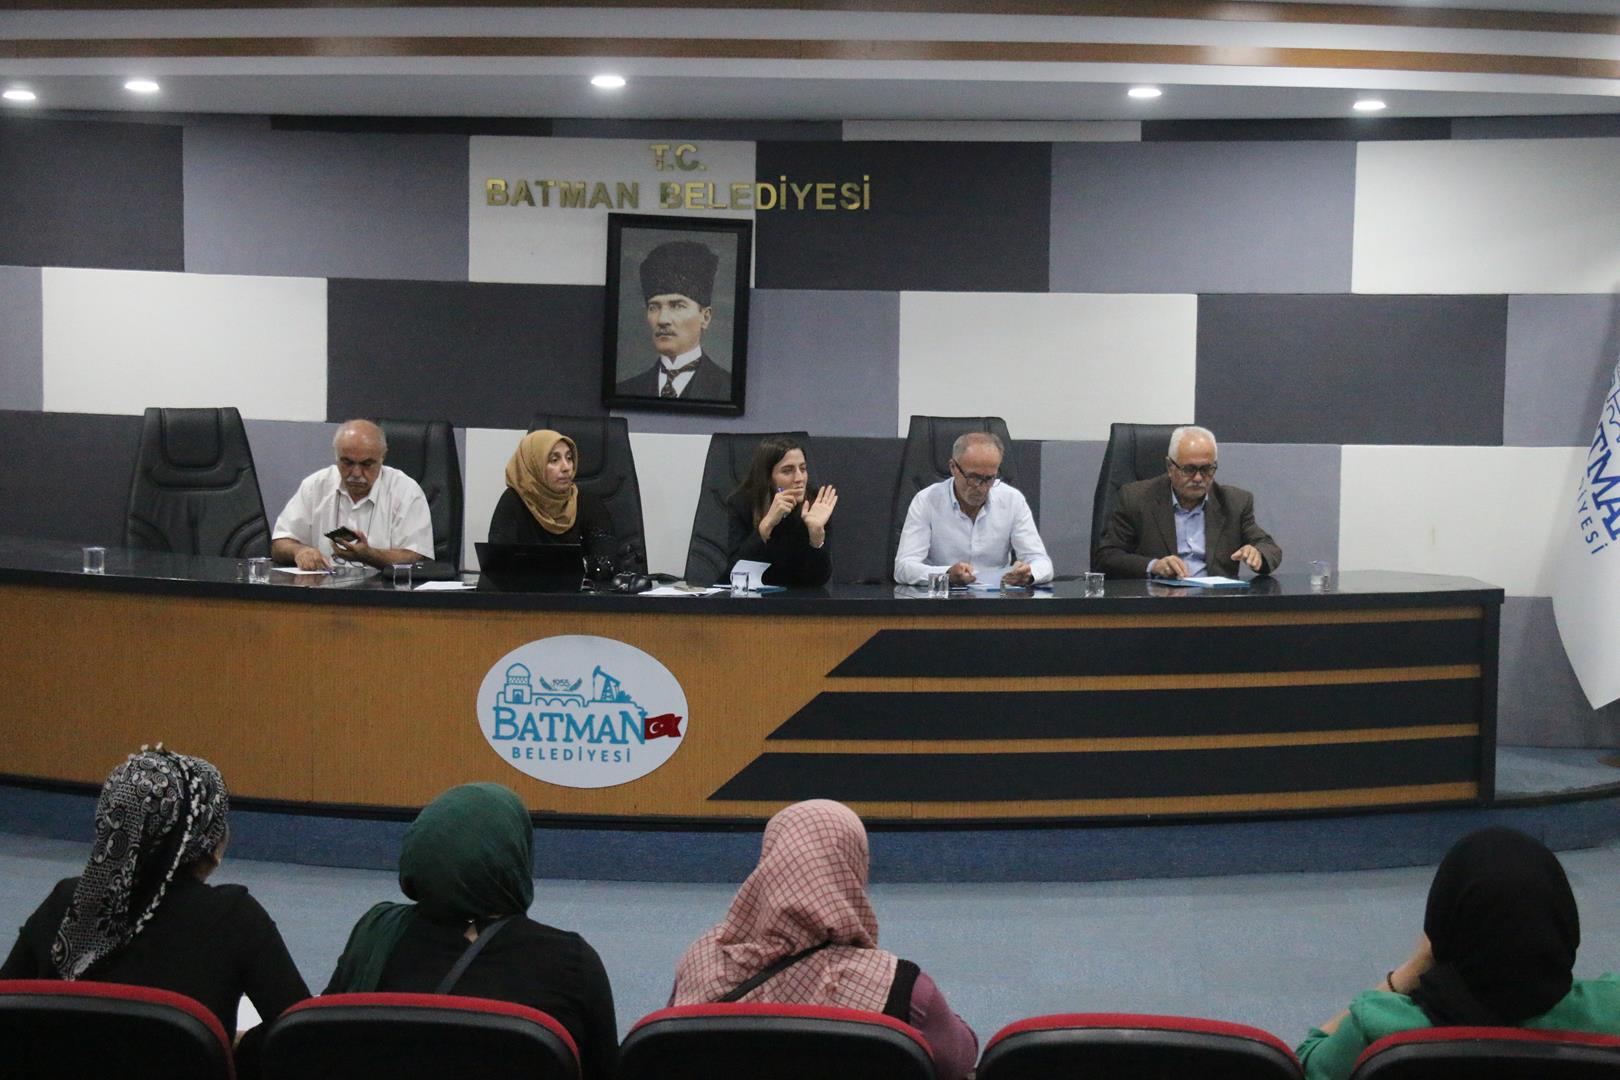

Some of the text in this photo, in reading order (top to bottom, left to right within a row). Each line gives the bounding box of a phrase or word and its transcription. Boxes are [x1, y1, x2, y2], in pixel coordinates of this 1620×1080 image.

[650, 143, 707, 172] T.C.
[486, 174, 871, 211] BATMAN BELEDİYESİ
[492, 706, 648, 745] BATMAN
[512, 746, 632, 763] BELEDİYESİ
